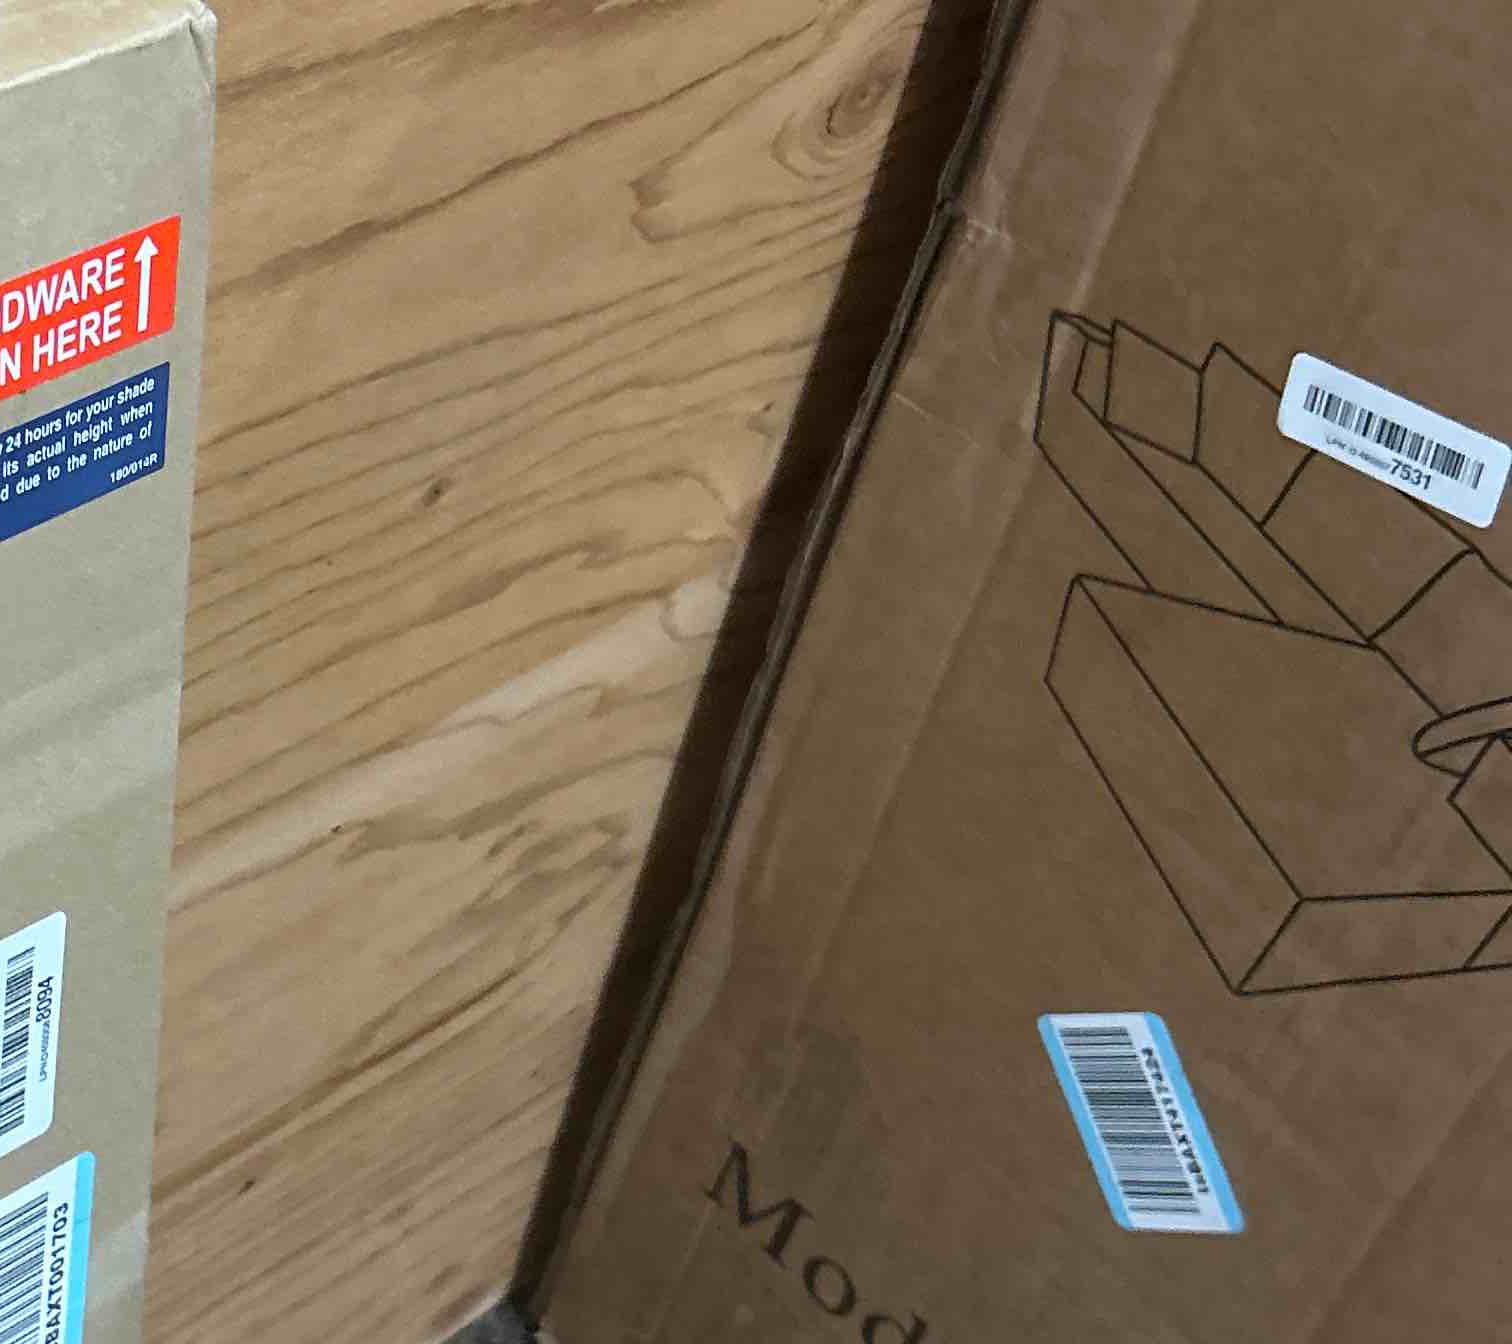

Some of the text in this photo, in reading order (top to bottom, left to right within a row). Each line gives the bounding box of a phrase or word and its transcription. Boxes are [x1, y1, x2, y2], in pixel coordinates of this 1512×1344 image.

[32, 299, 124, 373] HERE
[2, 459, 19, 478] its
[26, 436, 66, 467] actual
[73, 416, 113, 447] height
[120, 401, 153, 426] when
[5, 432, 22, 454] 24
[24, 418, 62, 445] hours
[65, 407, 84, 427] for
[85, 395, 115, 422] your
[116, 377, 155, 405] shade
[15, 474, 41, 495] due
[47, 464, 61, 481] to
[66, 453, 88, 473] the
[93, 432, 133, 461] nature
[139, 420, 153, 440] of
